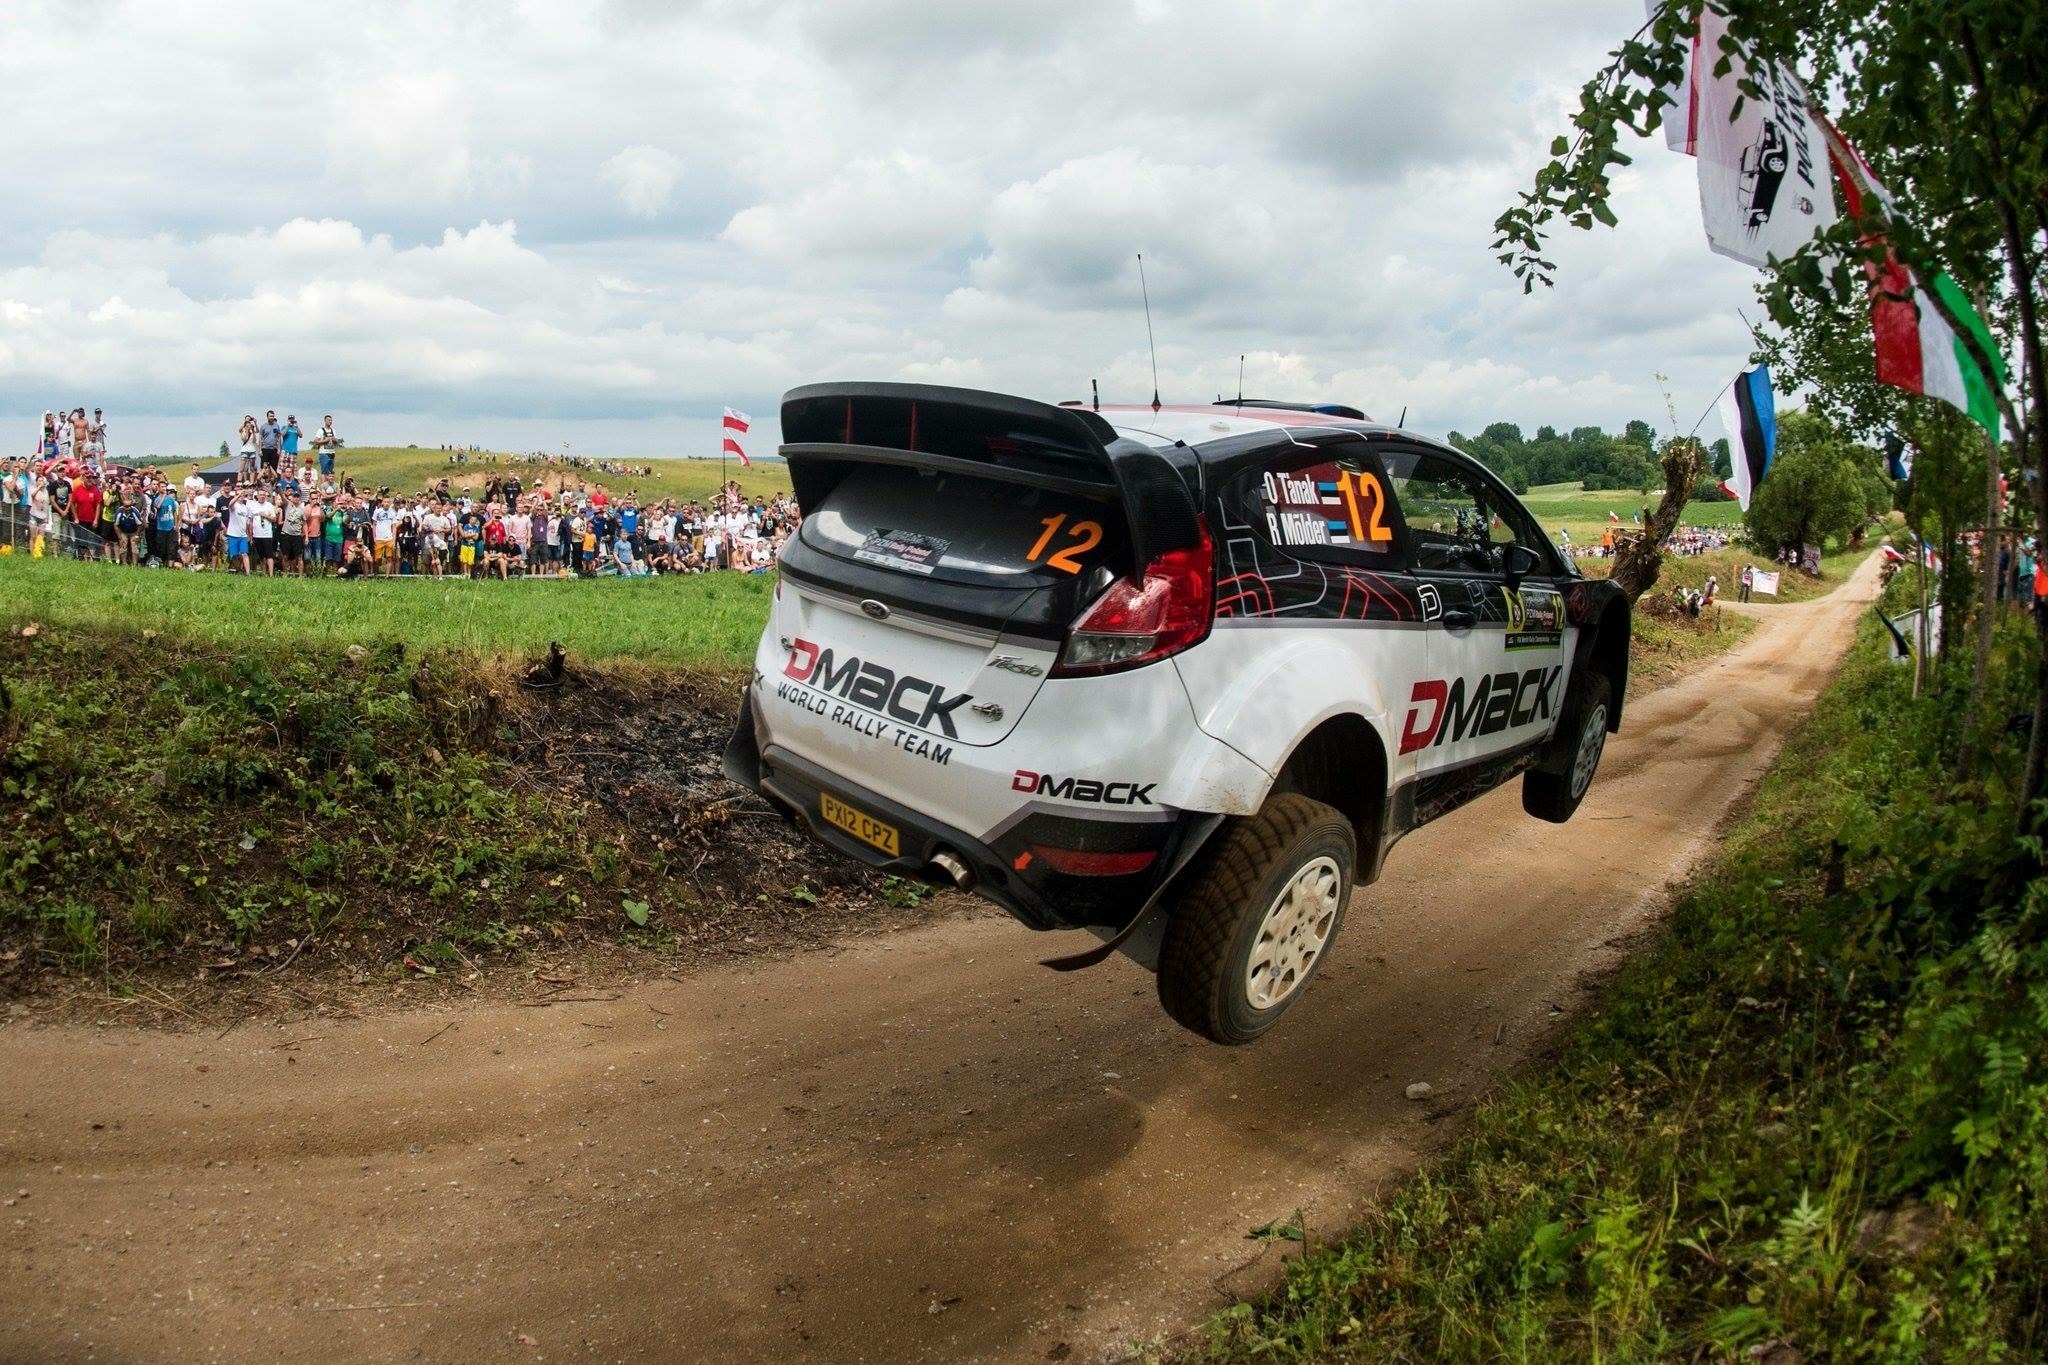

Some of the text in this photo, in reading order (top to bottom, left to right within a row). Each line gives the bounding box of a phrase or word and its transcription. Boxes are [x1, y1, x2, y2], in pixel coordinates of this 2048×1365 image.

[1263, 471, 1278, 504] O
[1337, 470, 1393, 541] 12
[1025, 513, 1104, 574] 12
[1266, 513, 1282, 545] R
[777, 682, 953, 765] WORLD RALLY TEAM
[826, 798, 893, 850] PX12 CPZ
